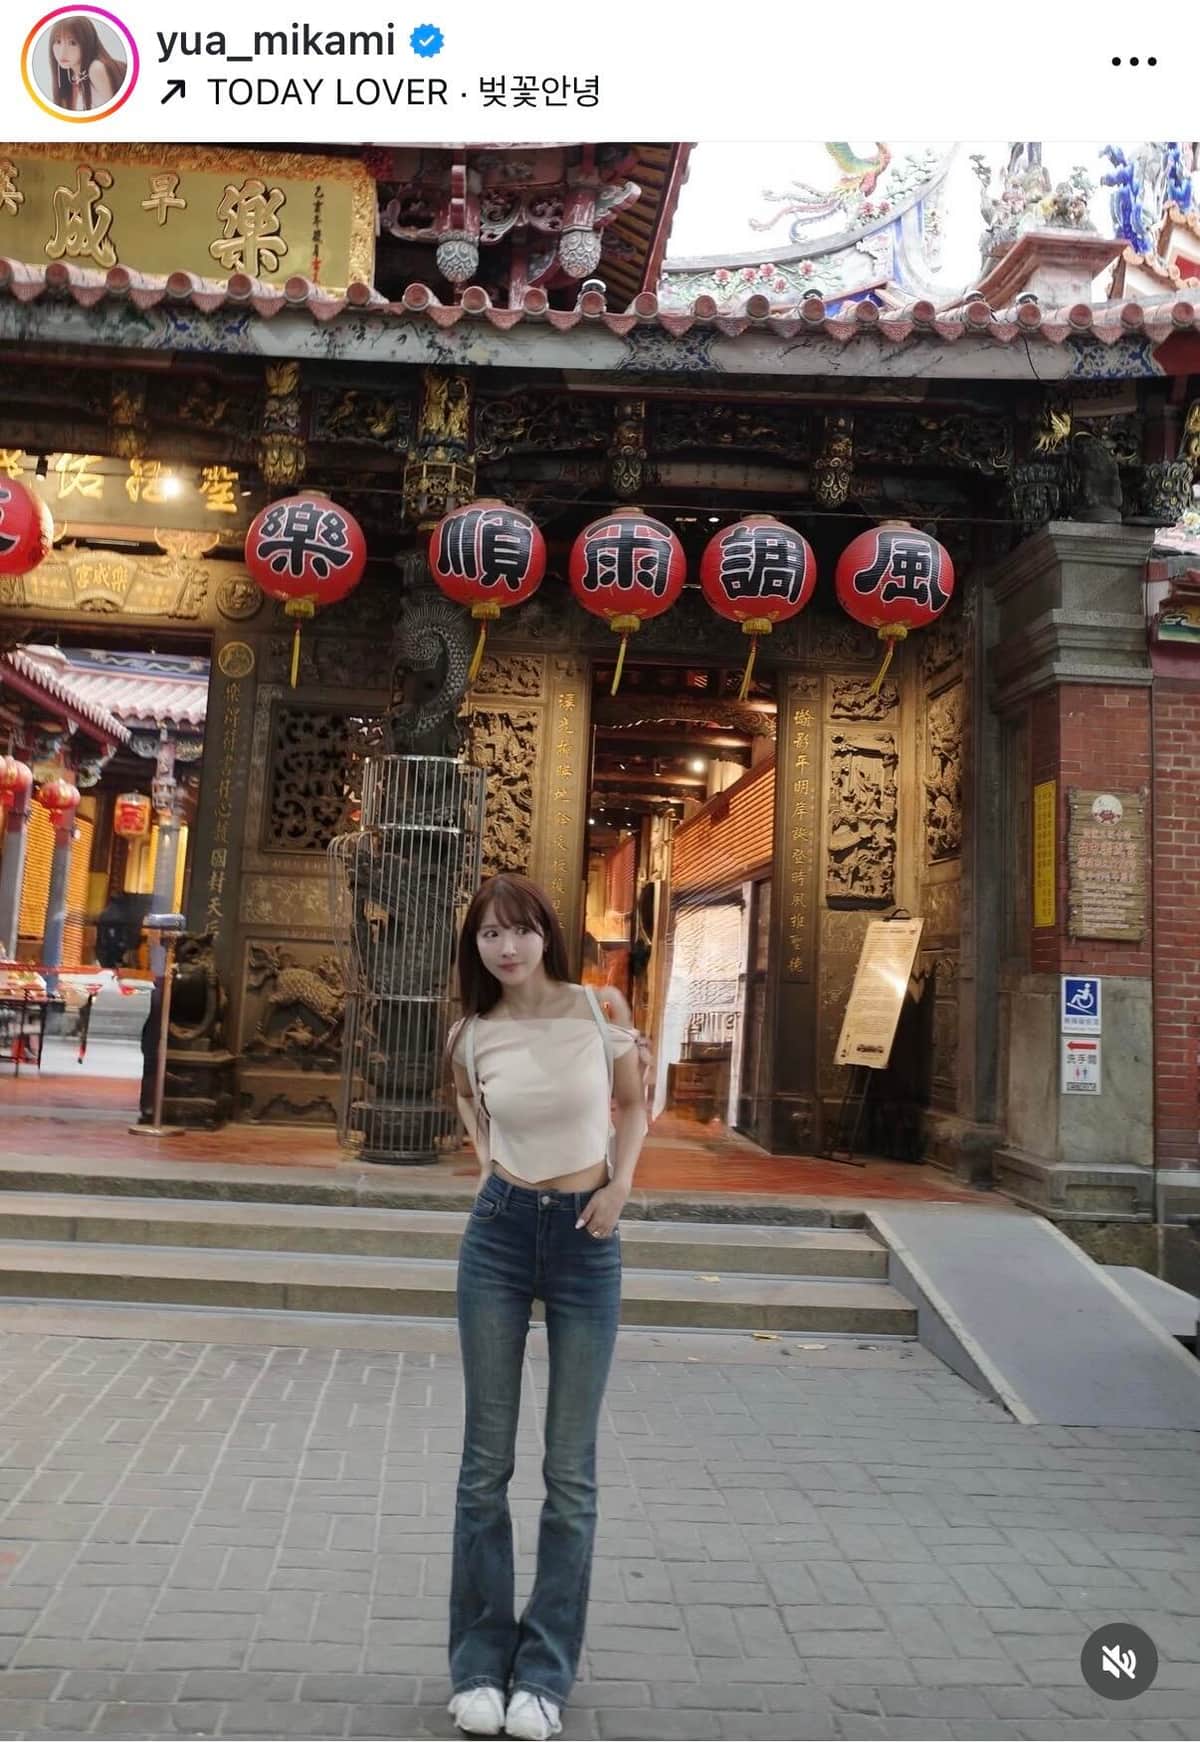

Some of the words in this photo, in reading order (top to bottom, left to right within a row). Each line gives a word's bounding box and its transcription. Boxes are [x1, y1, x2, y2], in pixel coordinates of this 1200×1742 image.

[258, 503, 352, 579] 樂
[436, 509, 533, 592] 順
[583, 518, 673, 597] 雨
[720, 525, 807, 603] 調
[853, 531, 952, 612] 風
